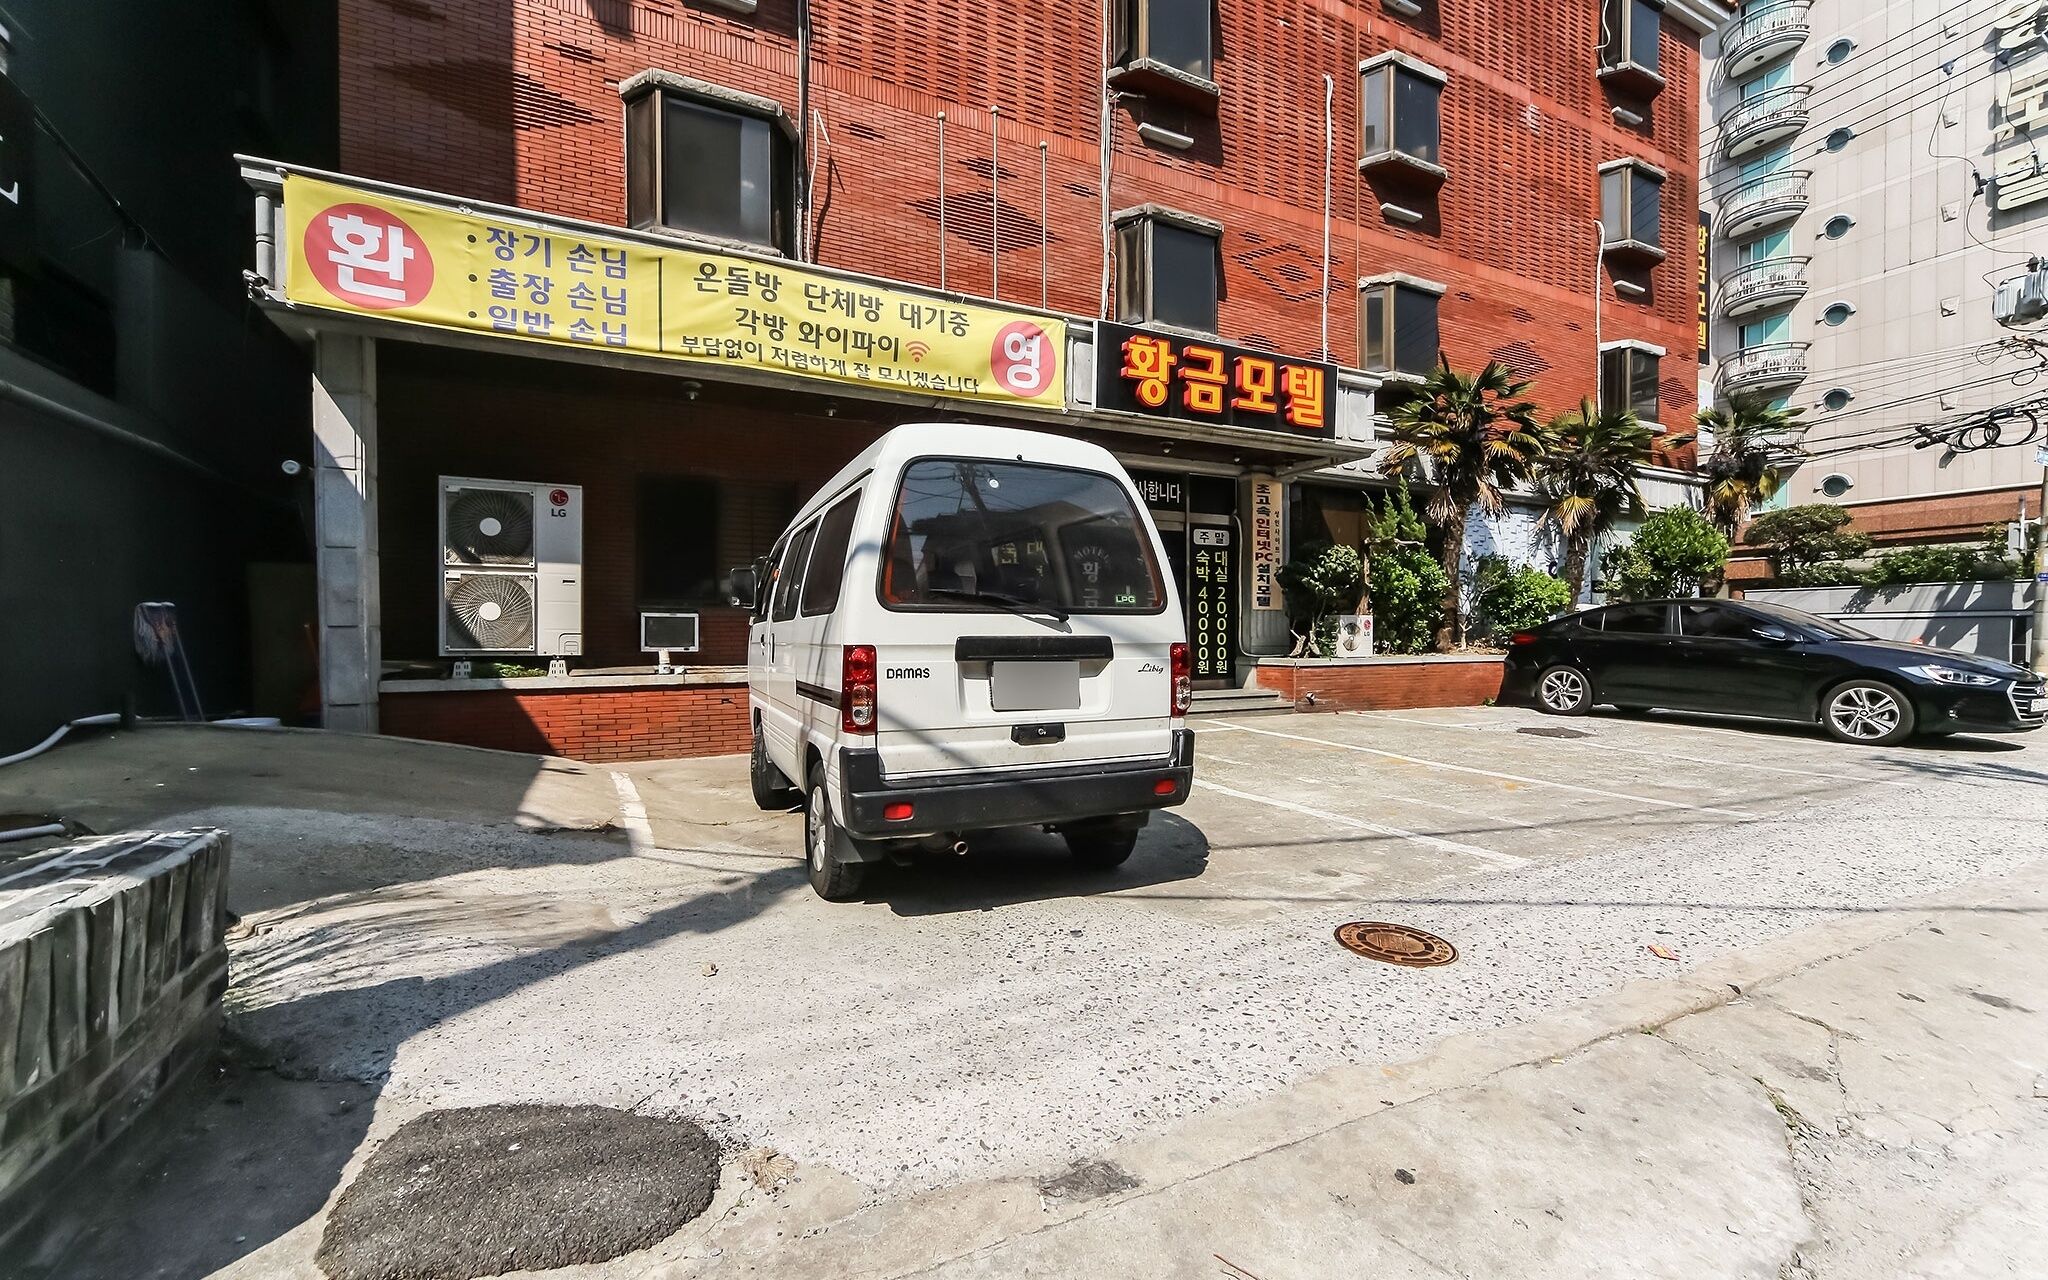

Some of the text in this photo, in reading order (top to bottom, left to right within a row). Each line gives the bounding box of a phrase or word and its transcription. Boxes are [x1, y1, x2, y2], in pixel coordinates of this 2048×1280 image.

[327, 213, 415, 302] 환
[486, 226, 628, 280] 장기 손님
[487, 268, 628, 317] 출장 손님
[693, 262, 970, 337] 온돌방 단체방 대기중
[487, 305, 628, 347] 일반 손님
[735, 307, 900, 362] 각방 와이파이
[681, 335, 980, 395] 부담없이 저렴하게 잘 모시겠습니다
[1003, 331, 1042, 391] 영
[1120, 334, 1325, 428] 황금모텔
[551, 508, 567, 518] LG
[1134, 479, 1181, 503] 사합니다
[1196, 550, 1211, 582] 숙박
[1214, 550, 1228, 583] 대실
[1115, 594, 1136, 603] LPG
[886, 667, 930, 679] DAMAS
